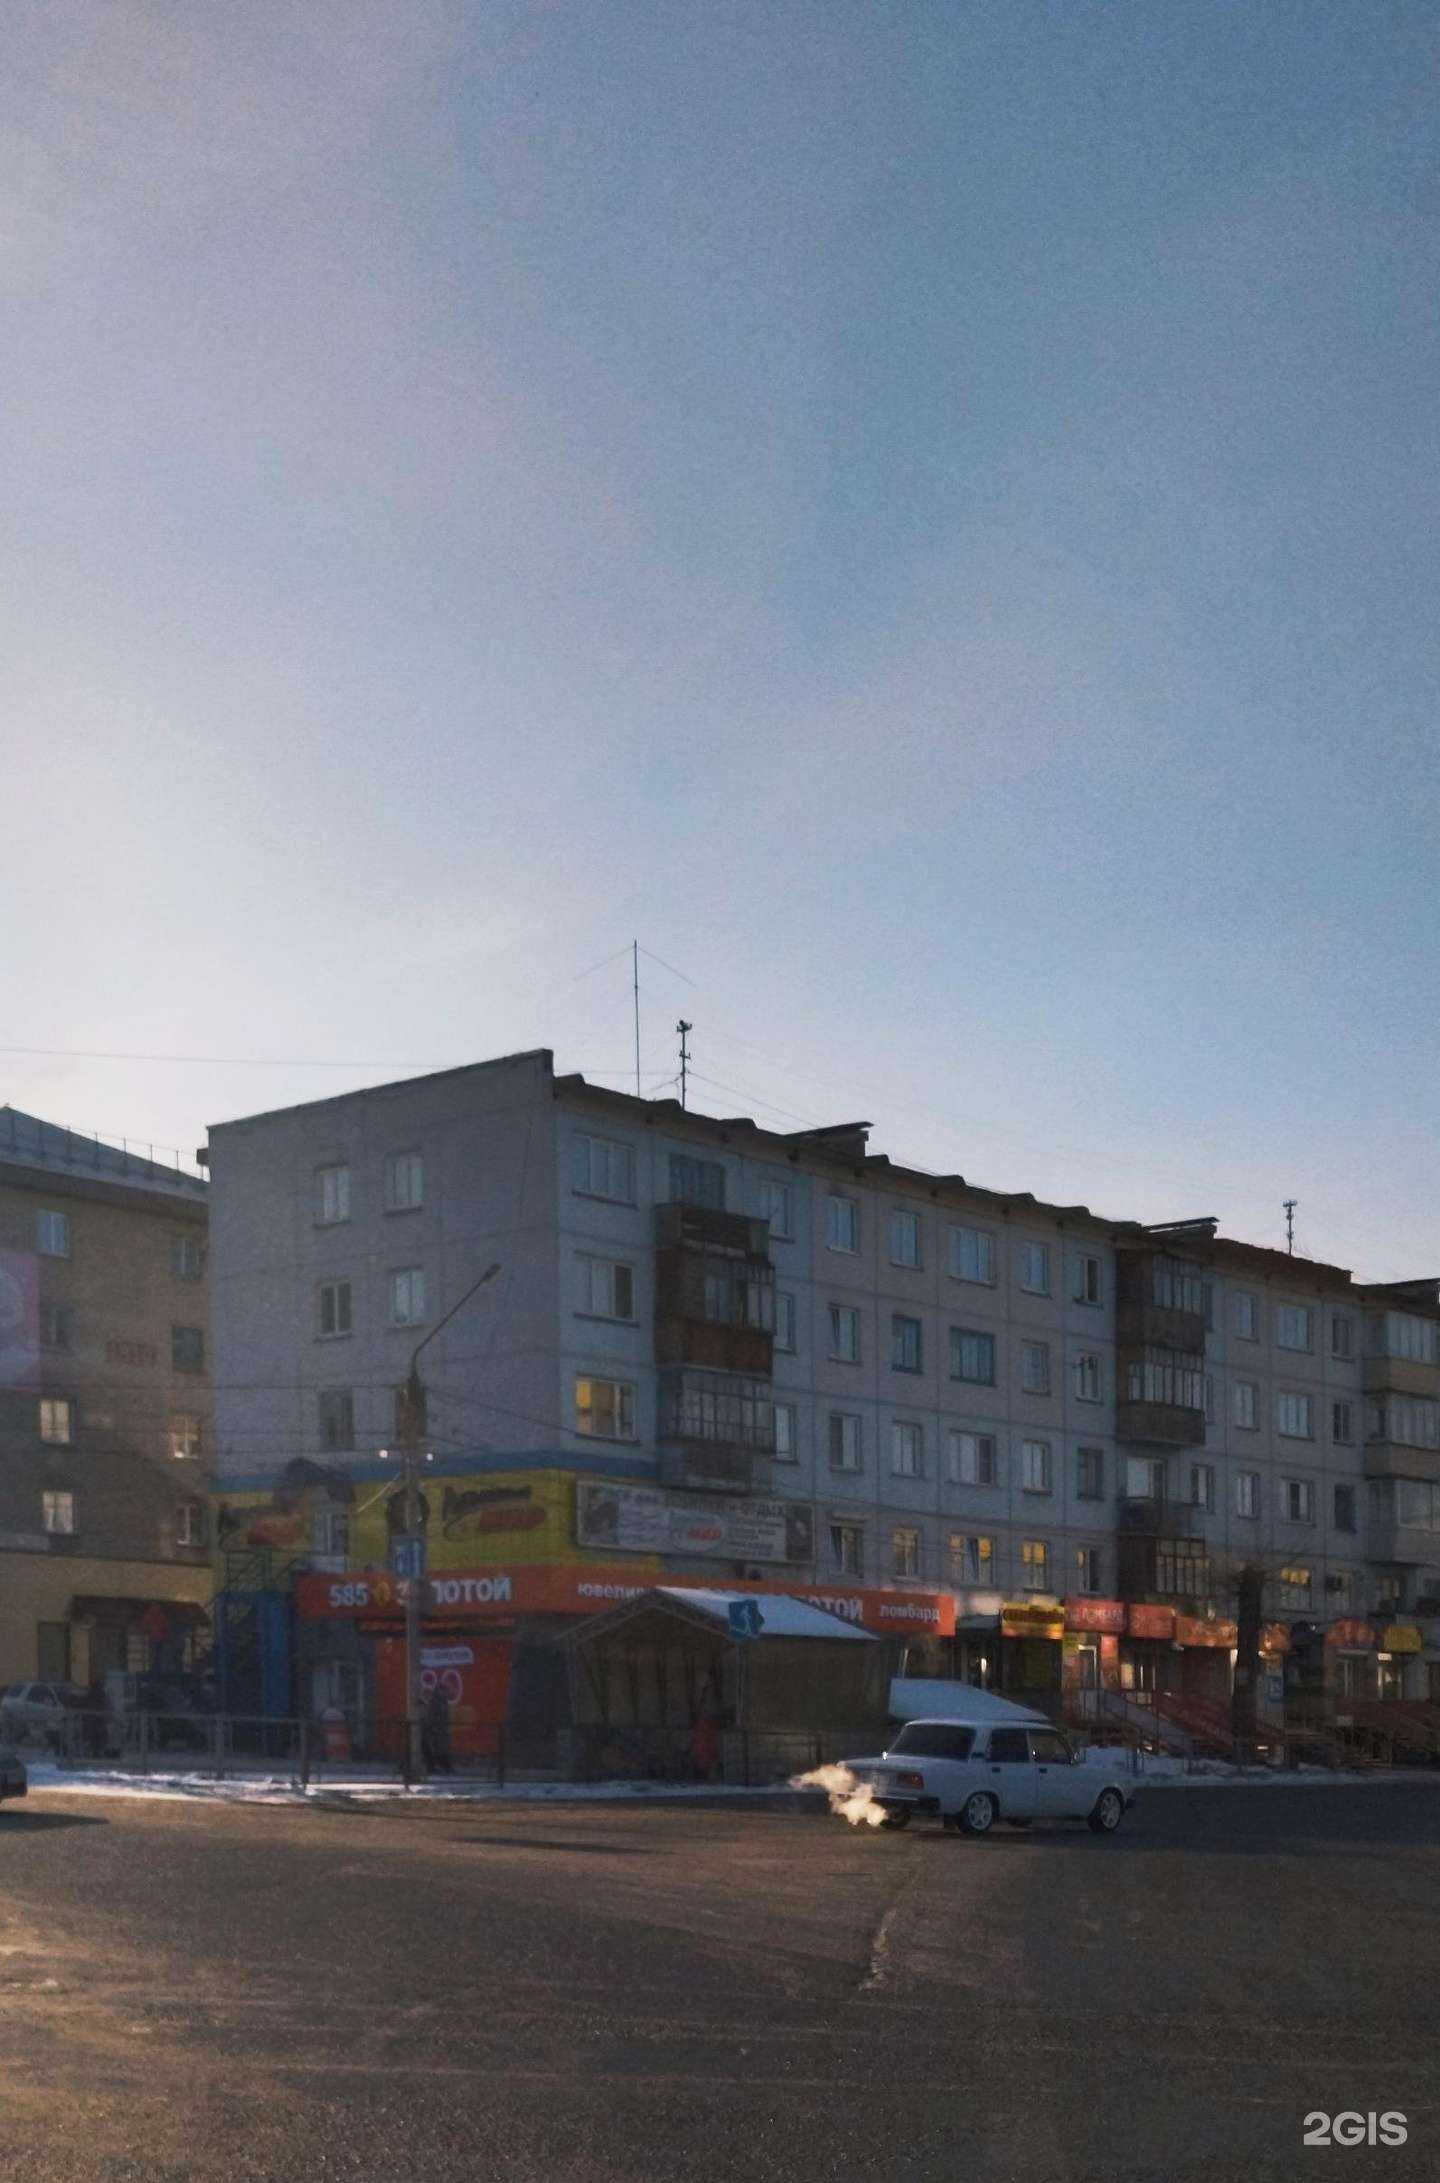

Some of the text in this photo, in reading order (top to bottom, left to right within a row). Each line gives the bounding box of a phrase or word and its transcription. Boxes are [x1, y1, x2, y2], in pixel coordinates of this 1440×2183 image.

[329, 1575, 512, 1607] 585 ЗЛОТОЙ
[879, 1603, 941, 1623] ломбард
